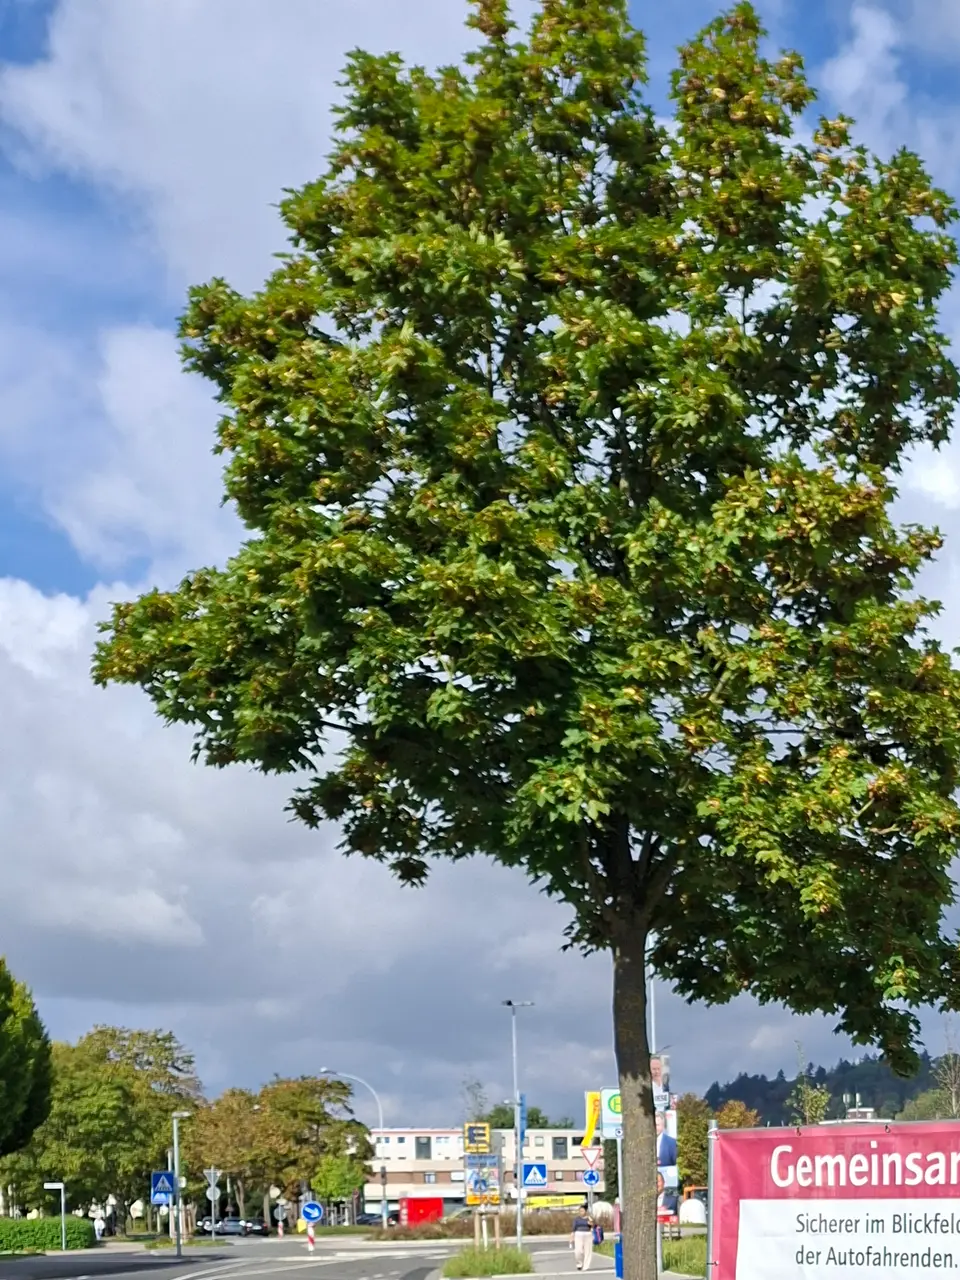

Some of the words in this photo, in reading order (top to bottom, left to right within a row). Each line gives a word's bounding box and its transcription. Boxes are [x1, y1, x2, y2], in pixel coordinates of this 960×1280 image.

[795, 1212, 860, 1234] Sicherer
[865, 1213, 885, 1233] im
[795, 1244, 821, 1266] der
[826, 1245, 958, 1268] Autofahrenden.
